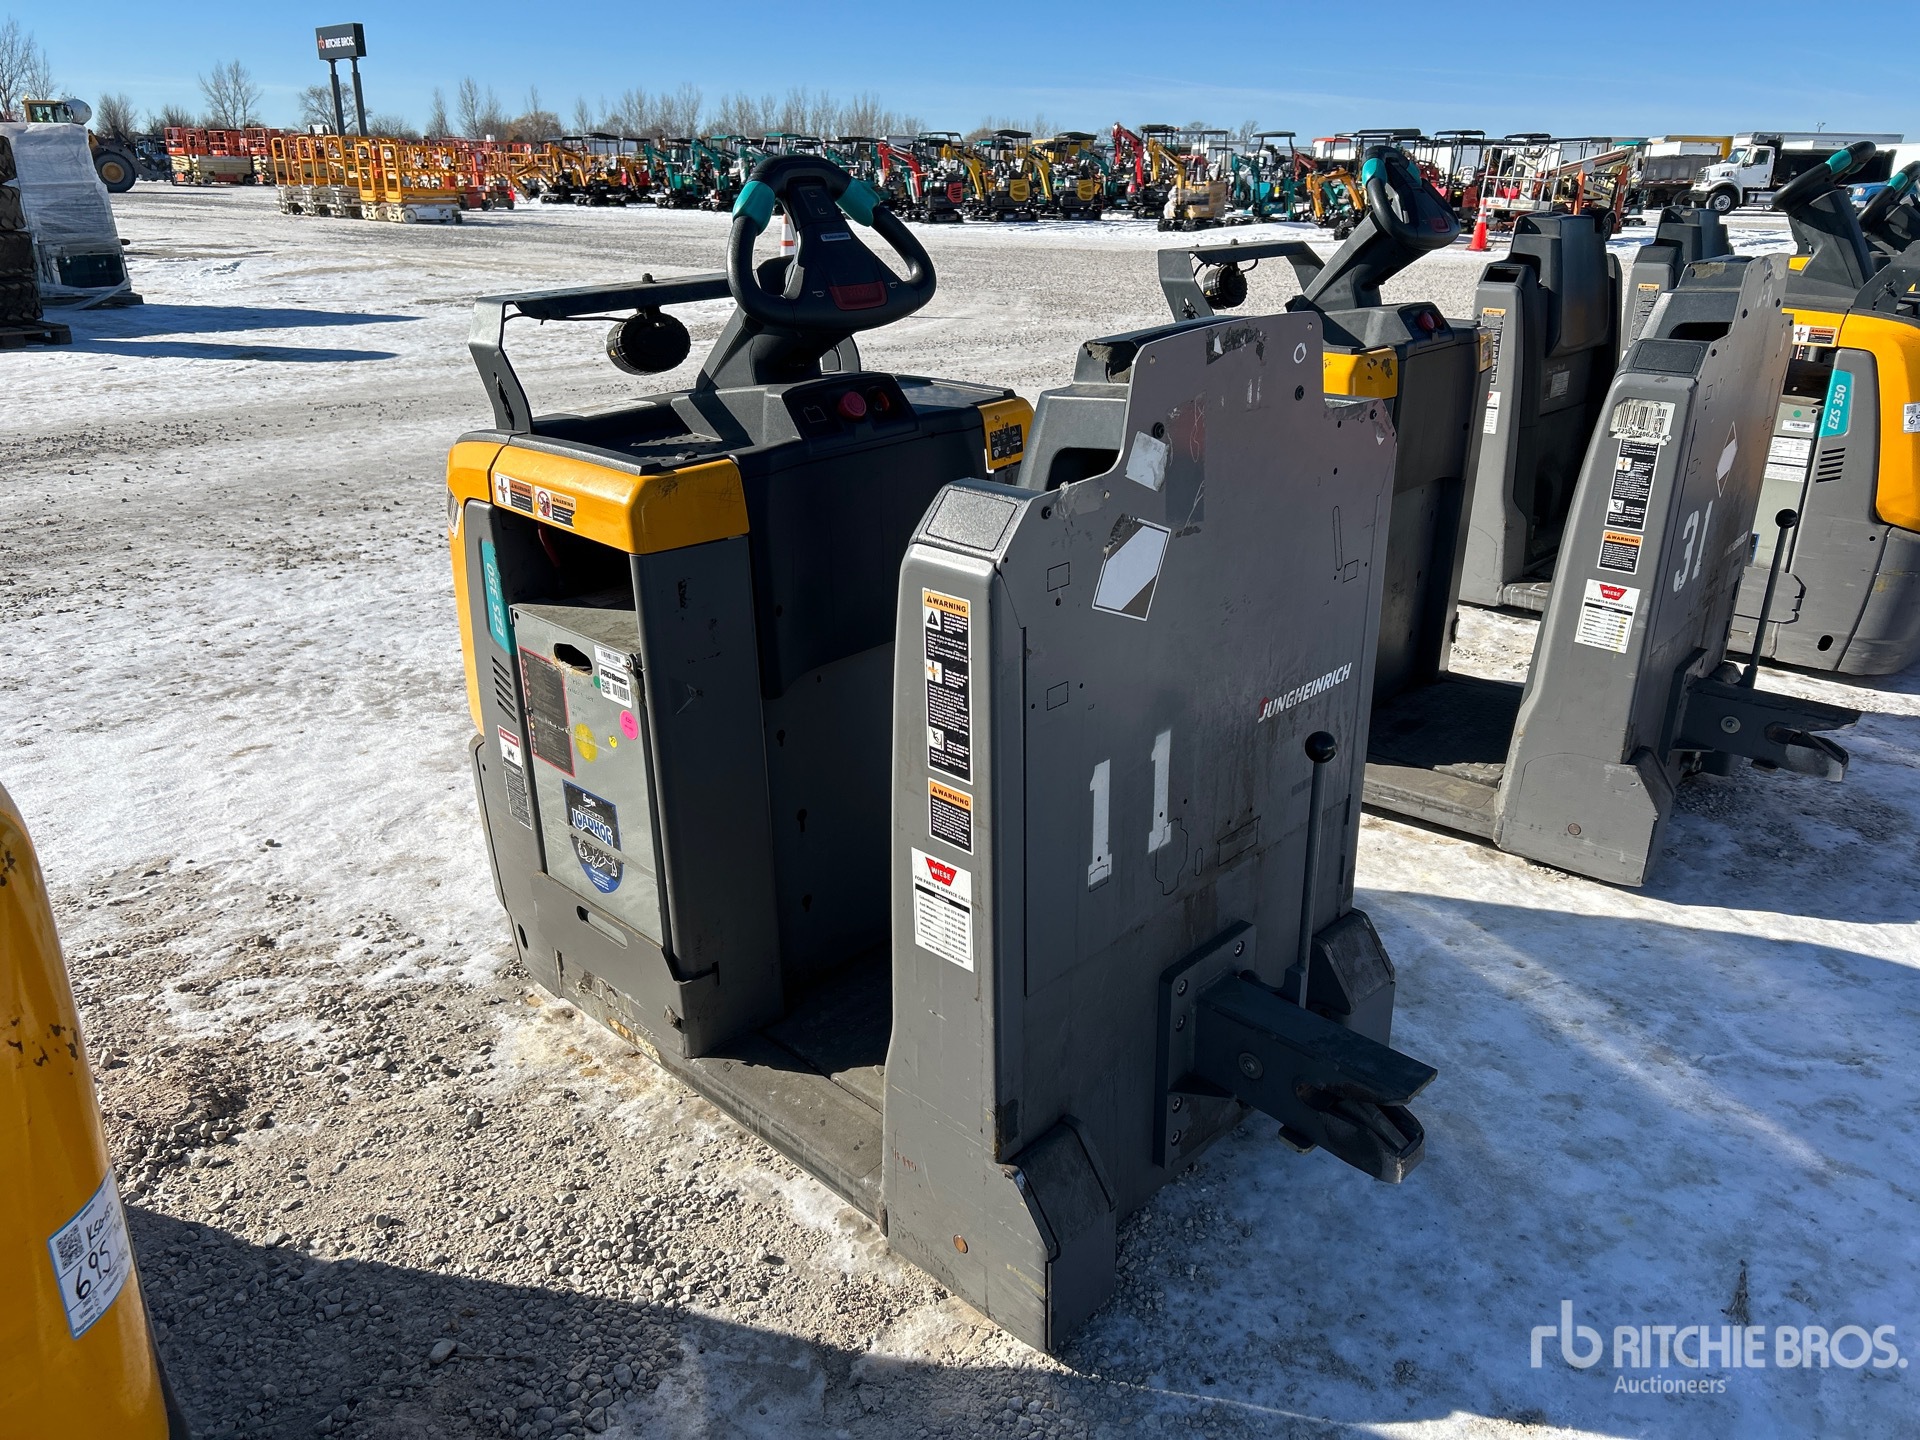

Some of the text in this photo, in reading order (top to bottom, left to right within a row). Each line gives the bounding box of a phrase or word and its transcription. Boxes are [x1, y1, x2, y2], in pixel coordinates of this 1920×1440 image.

[1827, 384, 1846, 430] EZS 350
[1611, 535, 1639, 544] WARNING
[1673, 500, 1713, 593] 31
[486, 563, 504, 638] EZS 350
[932, 598, 966, 613] WARNING
[1258, 662, 1352, 723] JUNGHEINRICH
[938, 789, 969, 807] WARNING
[931, 866, 952, 881] WIESE
[76, 1240, 112, 1300] 695
